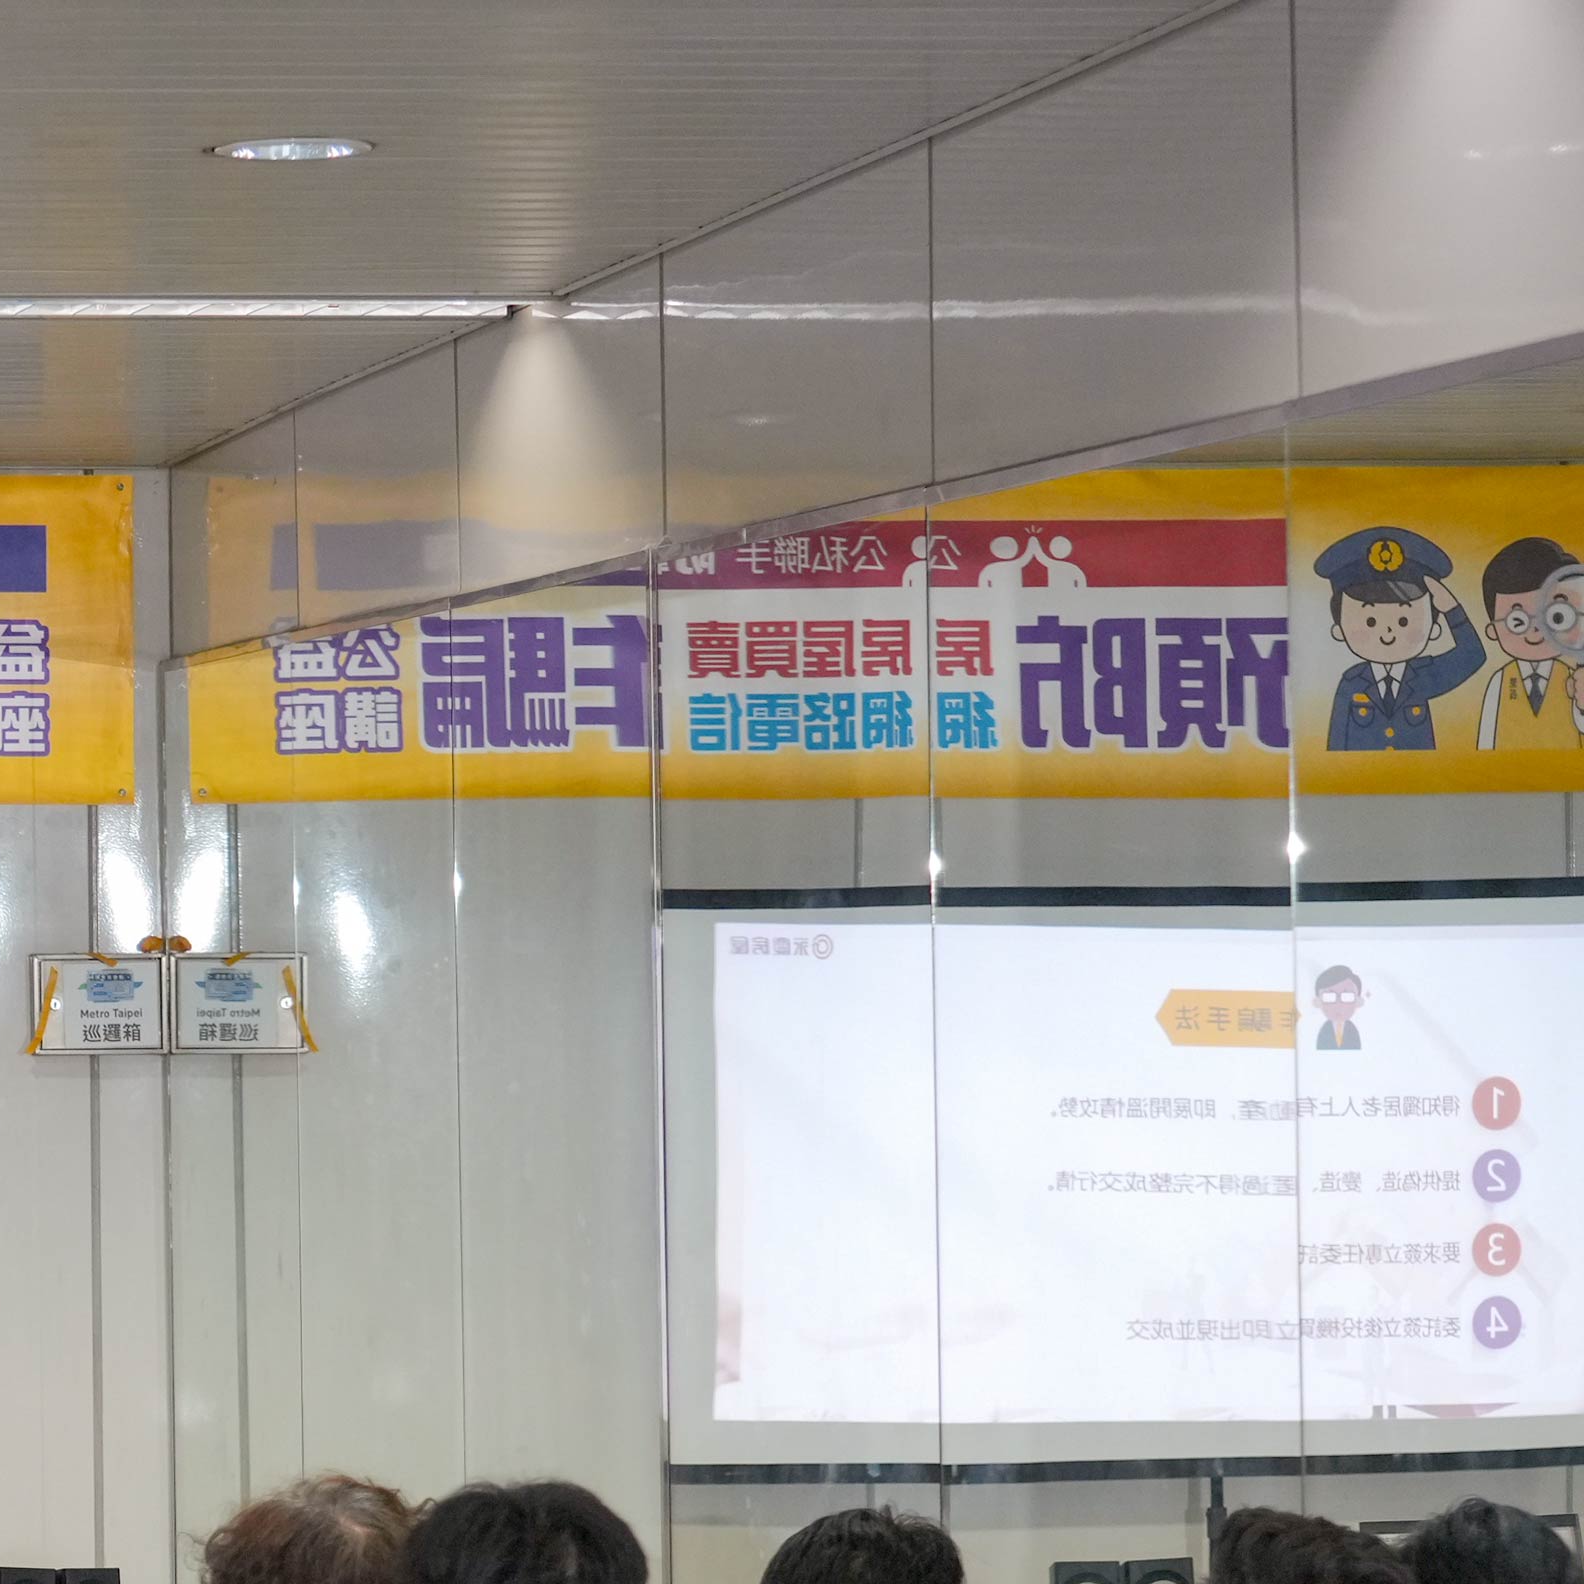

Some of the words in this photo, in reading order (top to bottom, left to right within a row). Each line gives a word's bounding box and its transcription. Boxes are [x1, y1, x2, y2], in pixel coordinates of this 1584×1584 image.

[80, 1009, 110, 1019] Metro
[113, 1007, 143, 1019] Taipei
[82, 1023, 142, 1043] 巡邏箱
